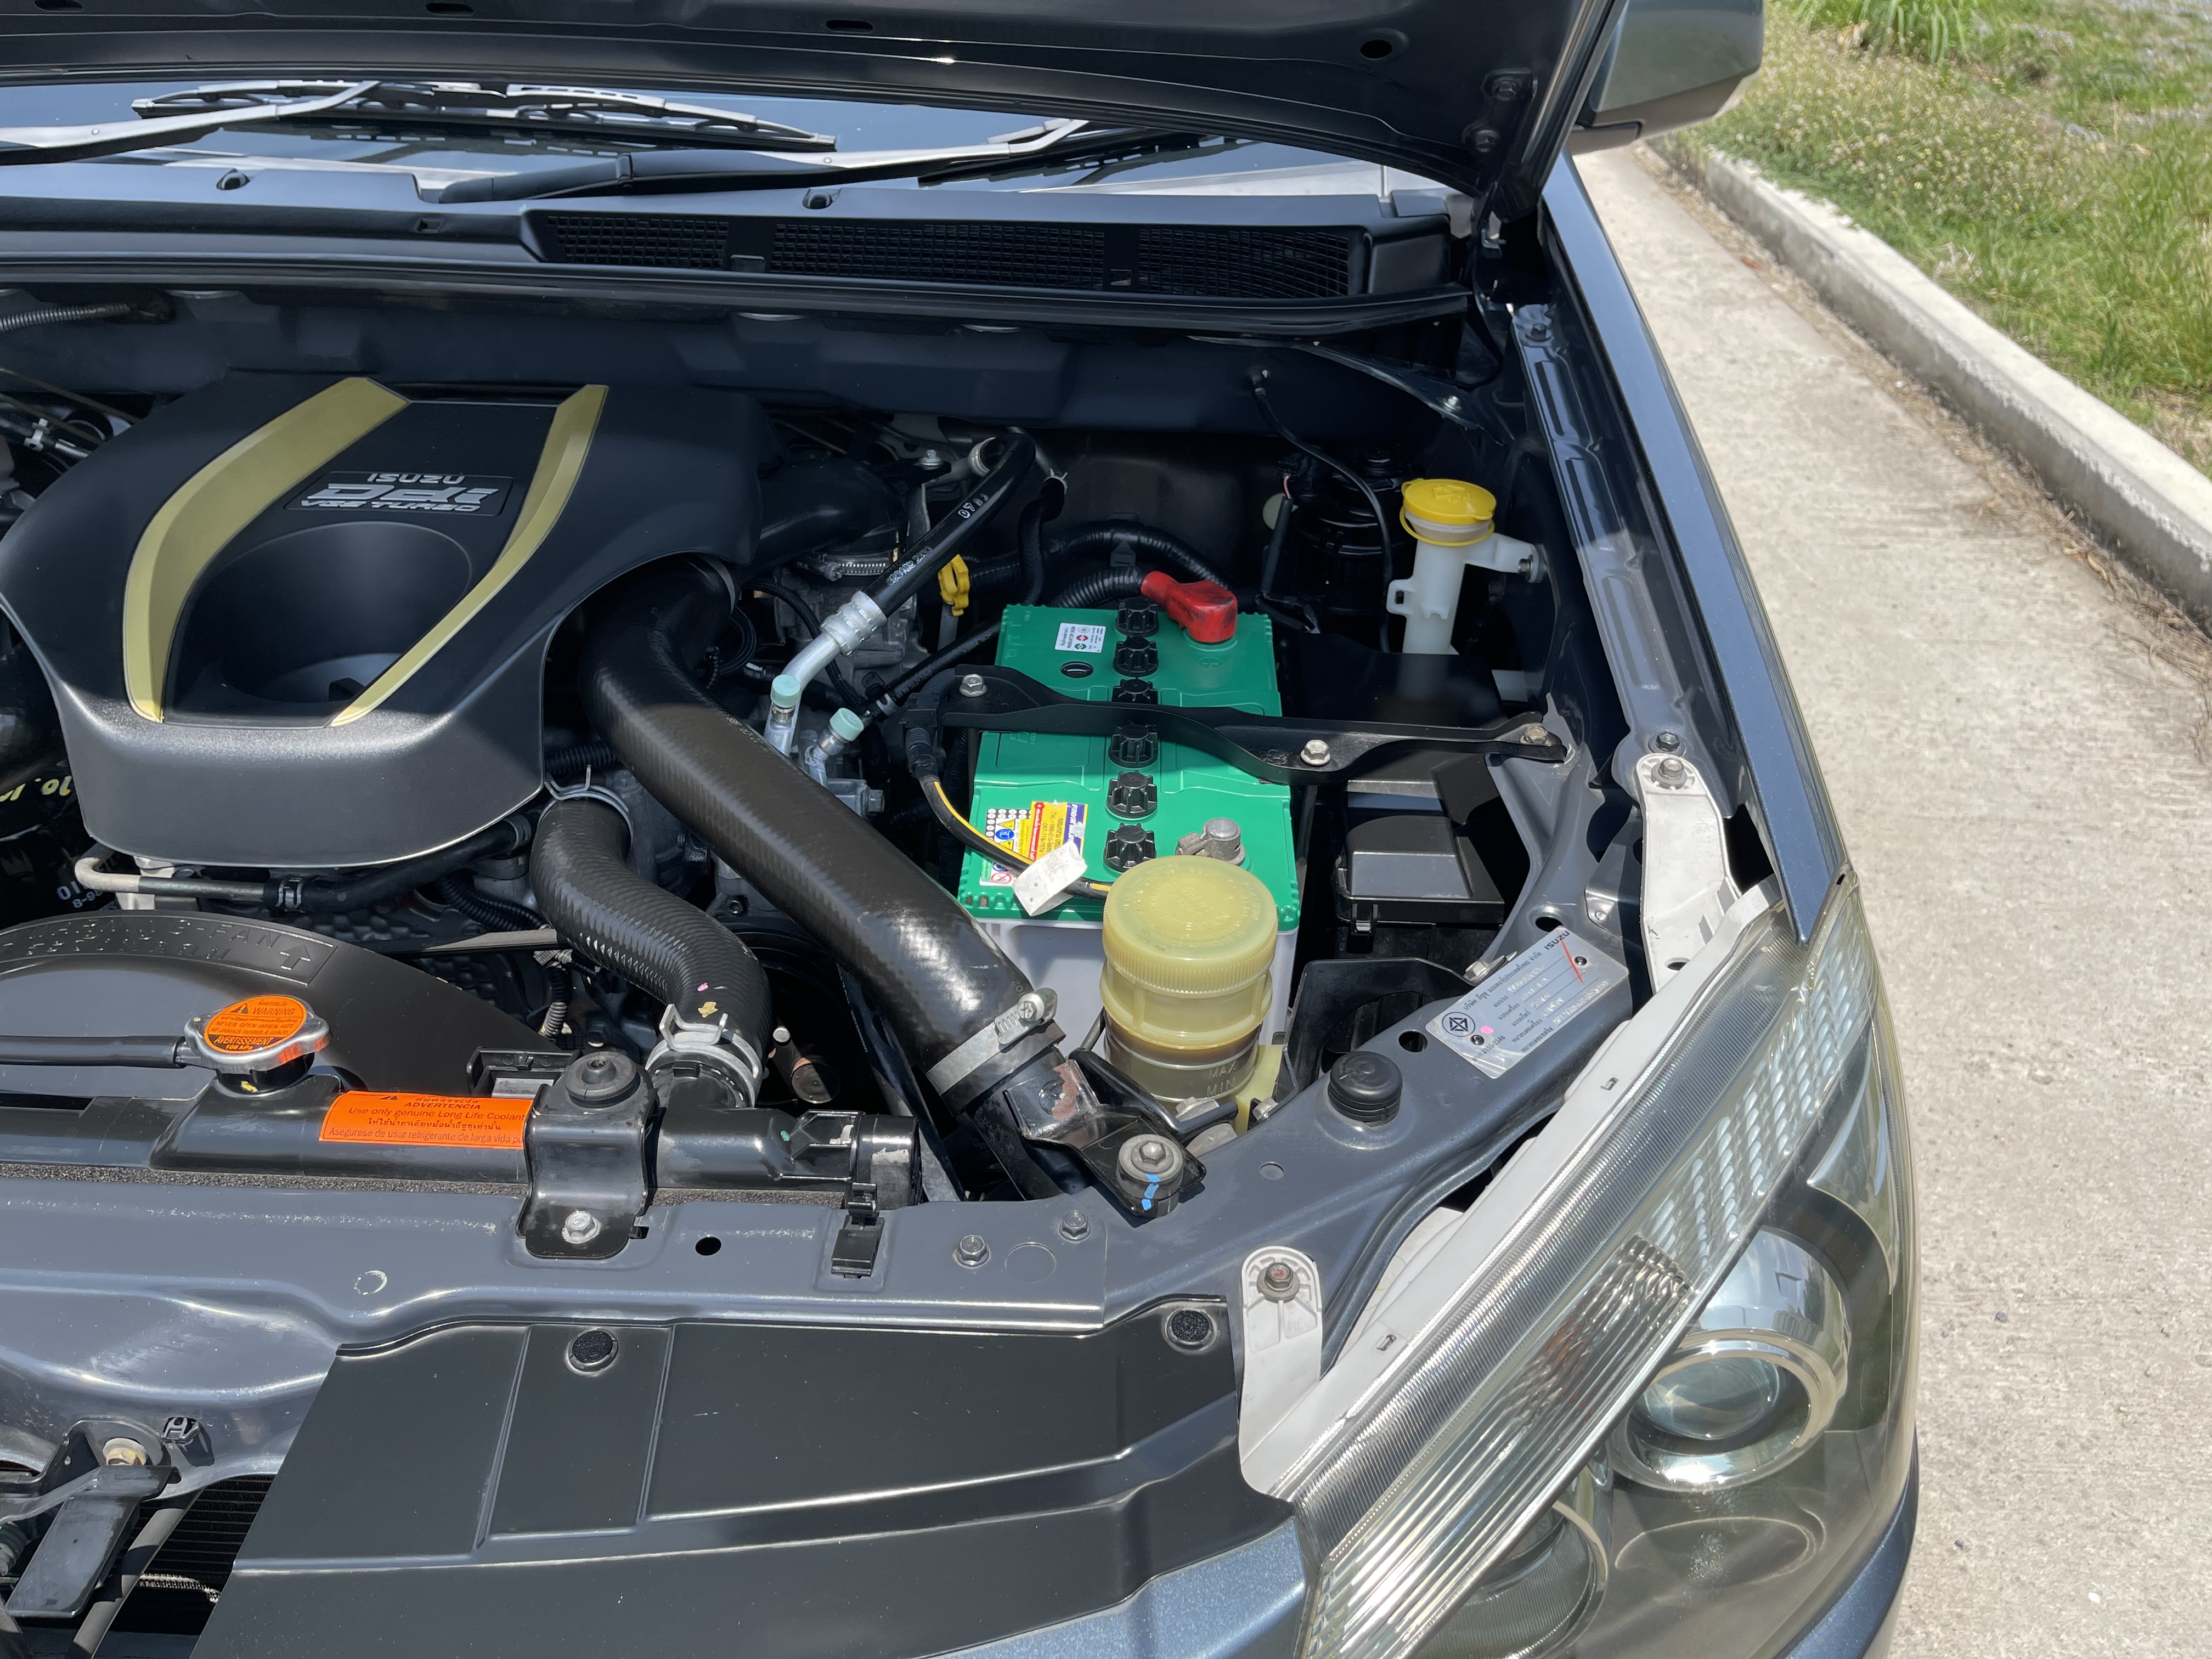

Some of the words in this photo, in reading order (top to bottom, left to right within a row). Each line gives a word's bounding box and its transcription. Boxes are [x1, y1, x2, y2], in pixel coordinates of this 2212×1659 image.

[367, 473, 466, 484] ISUZU
[371, 502, 480, 511] TURBO
[1544, 930, 1570, 950] ISUZU
[214, 1035, 273, 1045] AVERTISSEMENT
[1209, 1060, 1237, 1080] MAX
[1207, 1077, 1235, 1097] MIN
[371, 1108, 391, 1116] only
[395, 1109, 435, 1118] genuine
[438, 1111, 462, 1119] Long
[487, 1113, 525, 1121] Coolant
[329, 1127, 373, 1137] Asegurese
[409, 1131, 455, 1142] refrigerante
[471, 1134, 491, 1143] larga
